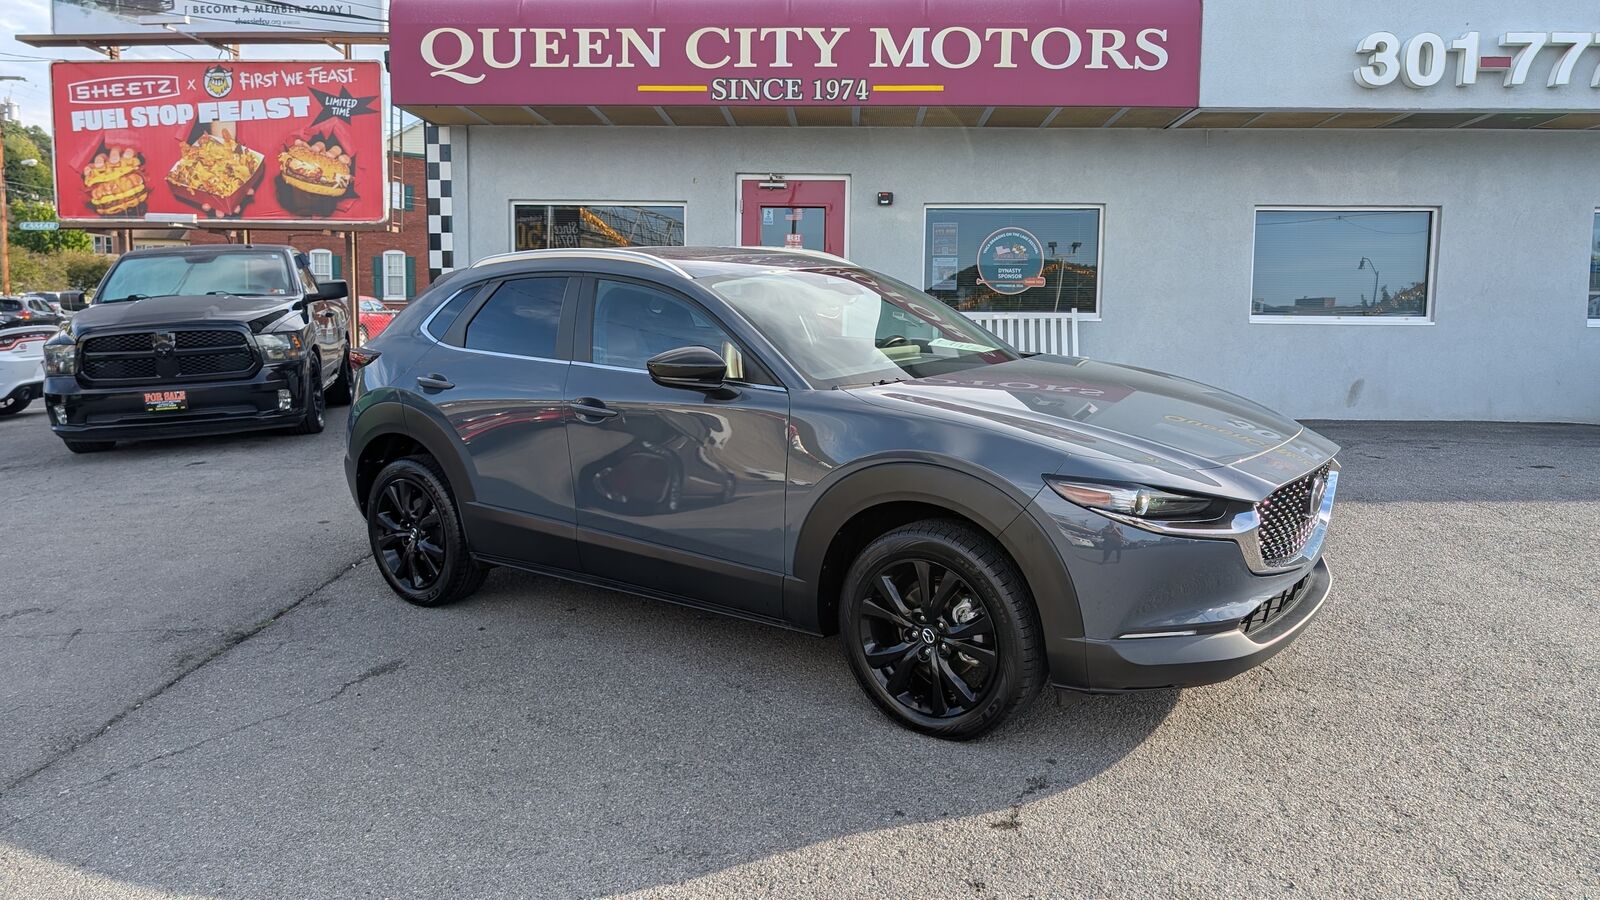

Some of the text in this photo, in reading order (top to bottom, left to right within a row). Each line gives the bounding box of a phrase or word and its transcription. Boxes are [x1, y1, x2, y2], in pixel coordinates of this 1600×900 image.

[192, 5, 238, 14] BECOME
[242, 5, 250, 13] A
[254, 5, 301, 14] MEMBER
[305, 5, 344, 14] TODAY
[420, 26, 1169, 84] QUEEN CITY MOTORS
[1353, 31, 1600, 88] 301-77
[76, 80, 171, 99] SHEETZ
[240, 71, 280, 90] FIRST
[281, 70, 304, 86] WE
[306, 66, 356, 86] FEAST
[711, 78, 870, 100] SINCE 1974
[325, 96, 358, 108] LIMITED
[332, 106, 352, 118] TIME
[71, 96, 310, 132] FUEL STOP FEAST
[144, 393, 164, 402] FOR
[164, 390, 186, 401] SALE
